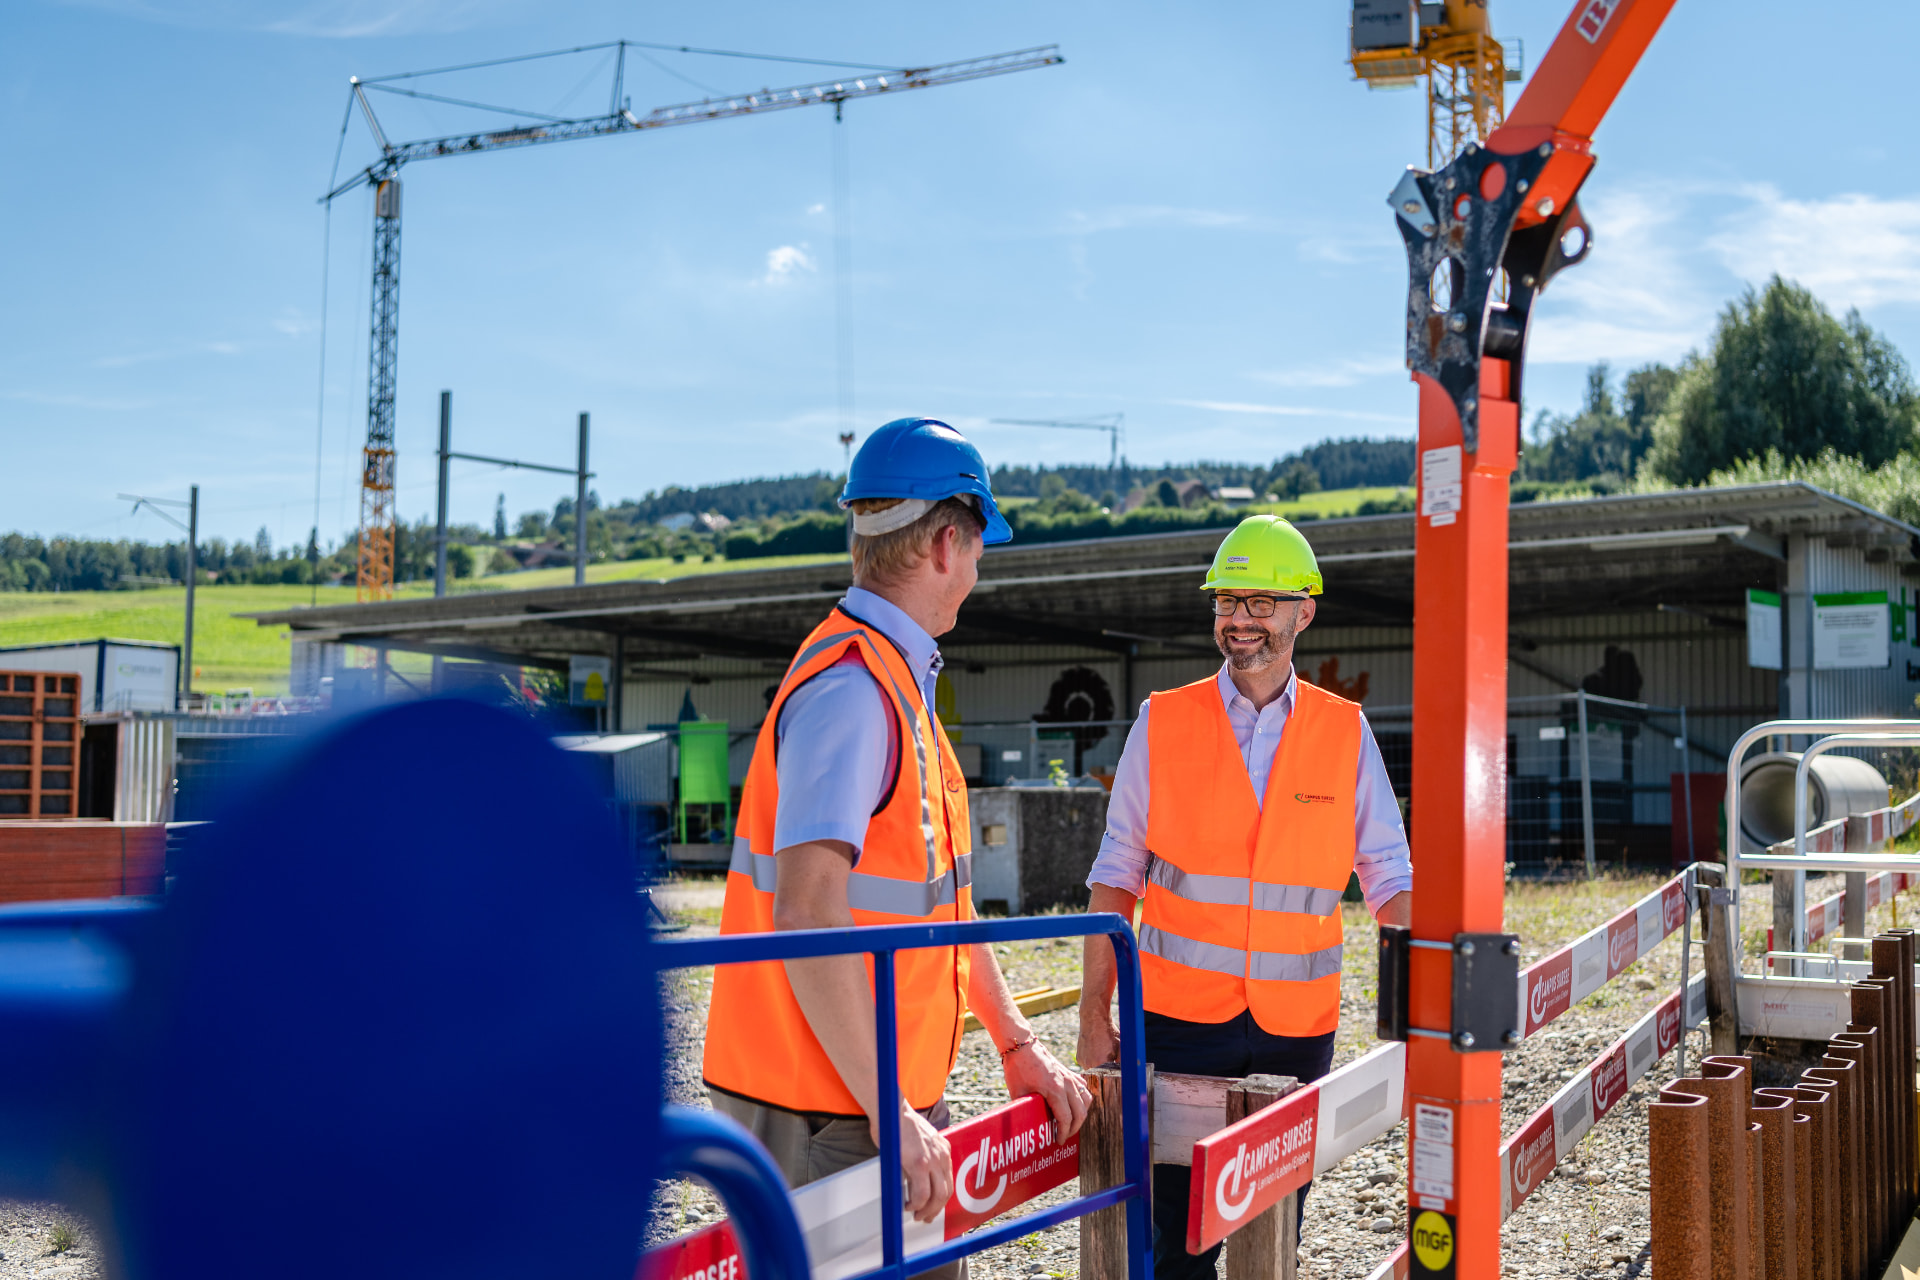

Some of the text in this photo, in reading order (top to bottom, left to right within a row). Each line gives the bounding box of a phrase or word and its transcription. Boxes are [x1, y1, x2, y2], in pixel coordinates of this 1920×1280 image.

[990, 1117, 1058, 1173] CAMPUS SUR
[1010, 1143, 1077, 1184] Lernen/Leben/Erleben
[1243, 1117, 1313, 1180] CAMPUS SURSEE
